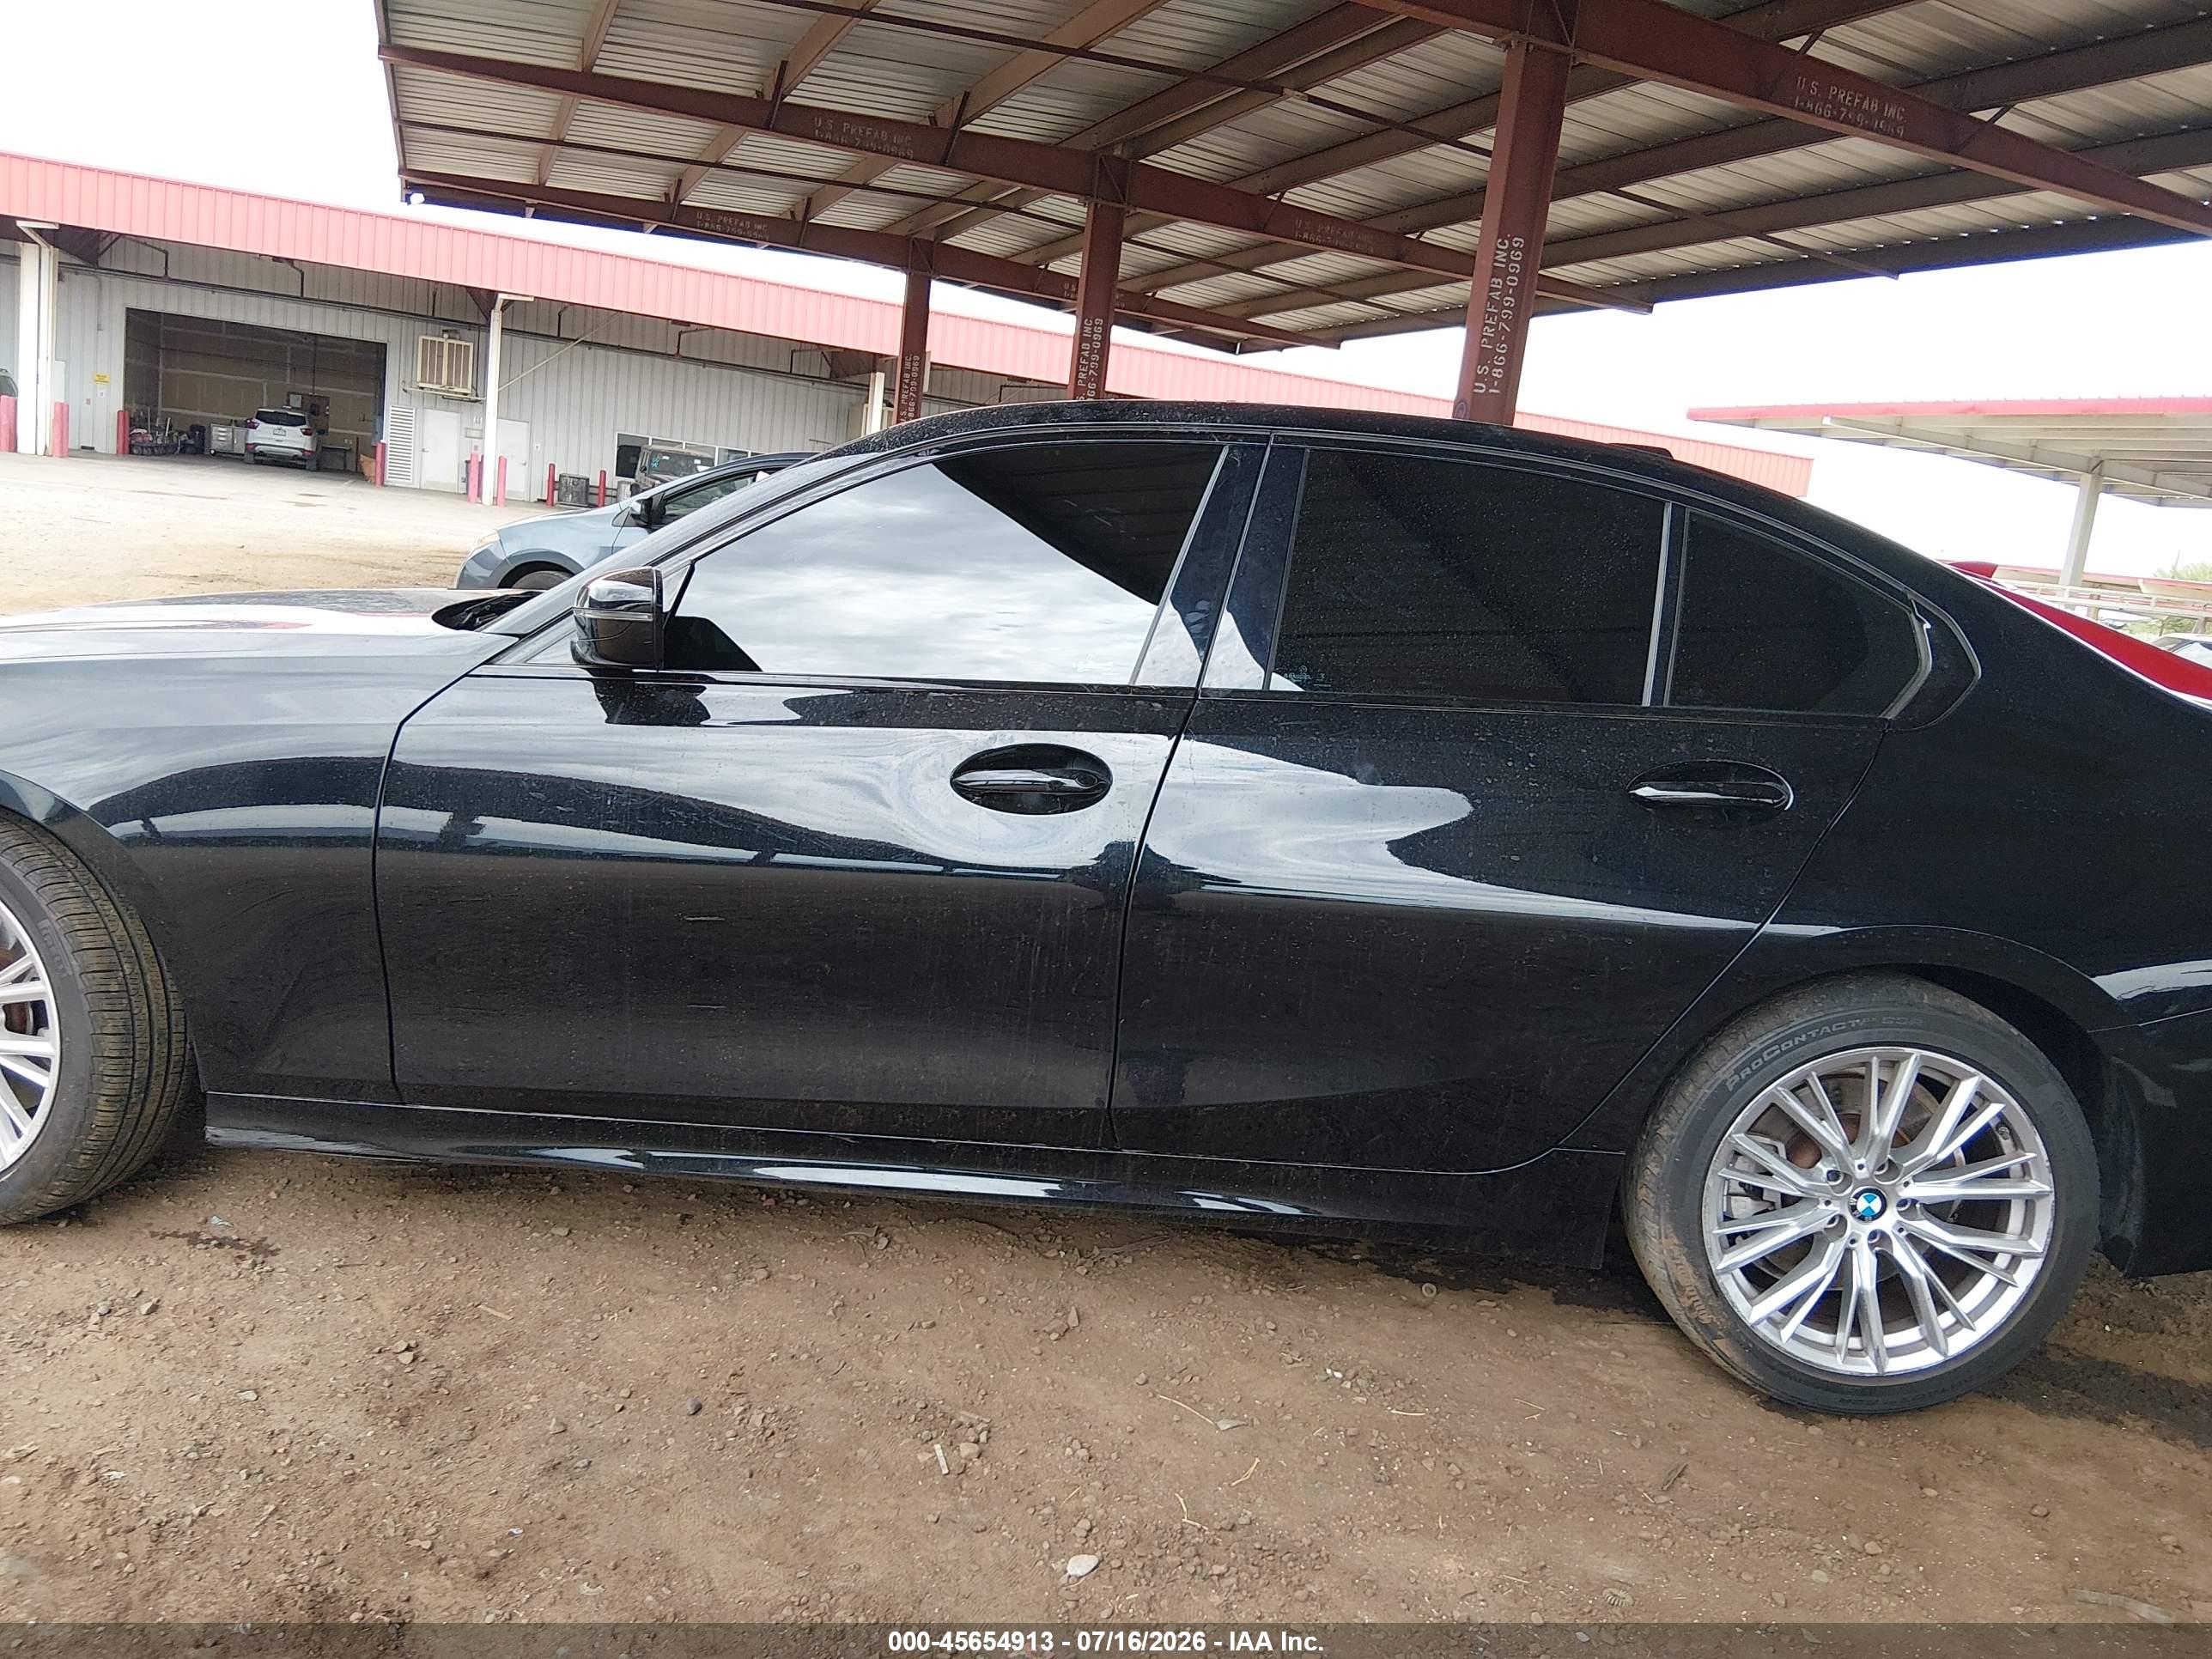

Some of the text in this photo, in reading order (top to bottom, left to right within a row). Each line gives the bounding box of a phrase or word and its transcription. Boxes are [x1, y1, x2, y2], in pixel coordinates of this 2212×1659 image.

[1829, 86, 1879, 112] PREFAB
[843, 123, 888, 141] PREFAB
[718, 216, 750, 228] PREFAB
[1473, 233, 1511, 394] U.S. PREFAB INC.
[1489, 237, 1524, 394] 1-866-799-0969
[1078, 343, 1091, 386] PREFAB
[1086, 318, 1103, 401] 66-799-0969
[901, 374, 911, 404] PREFAB
[907, 355, 920, 422] -866-799-0969
